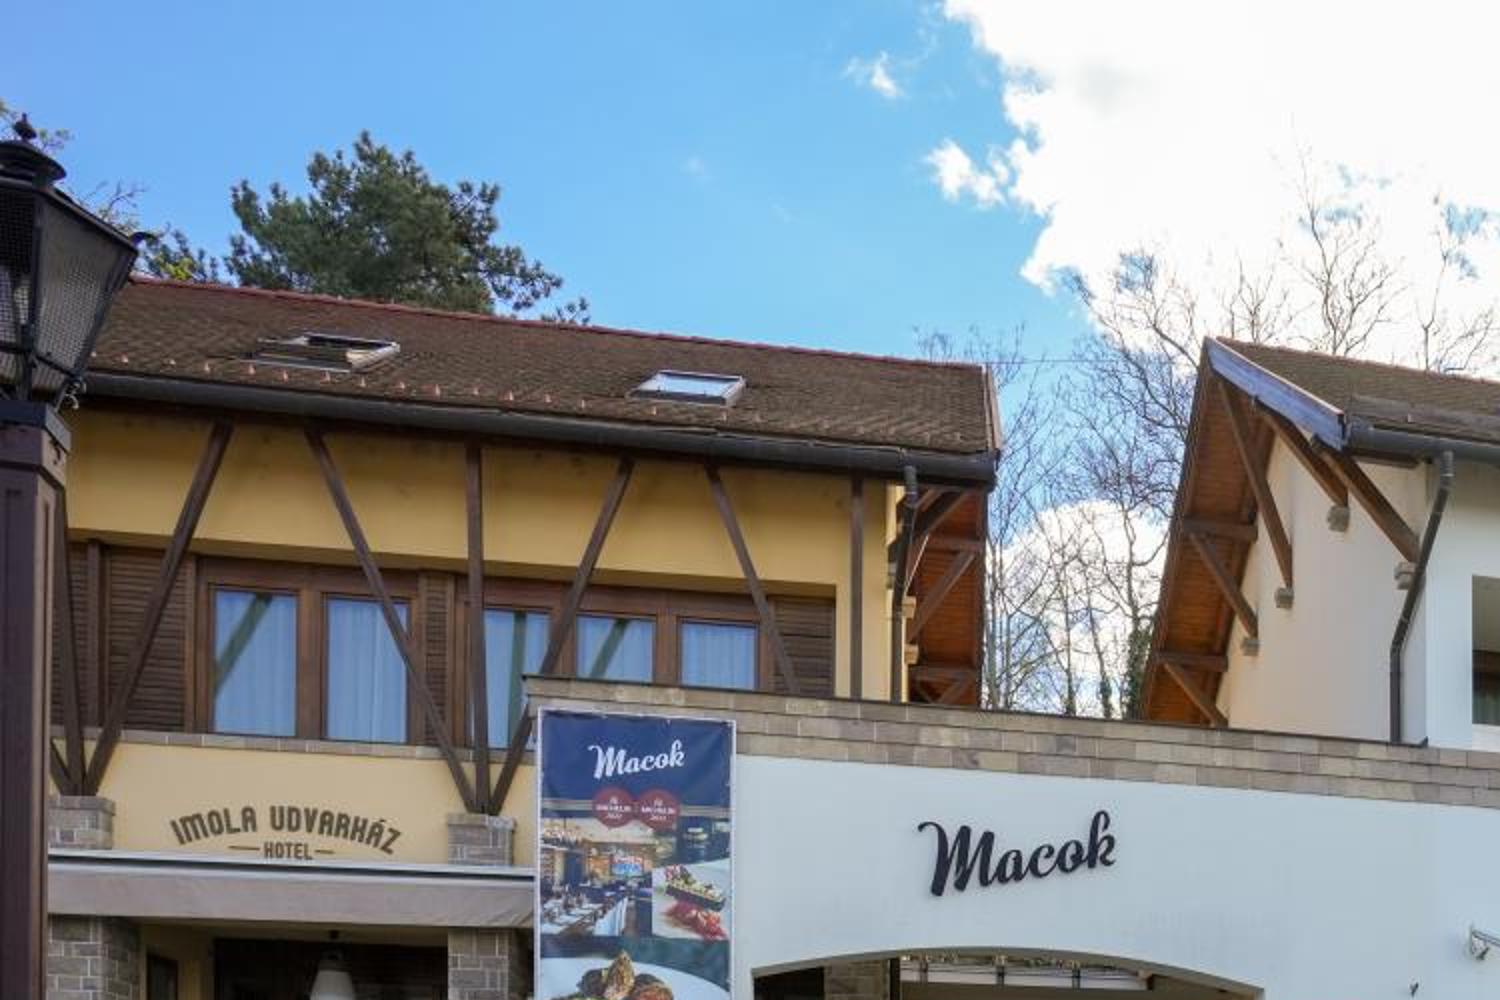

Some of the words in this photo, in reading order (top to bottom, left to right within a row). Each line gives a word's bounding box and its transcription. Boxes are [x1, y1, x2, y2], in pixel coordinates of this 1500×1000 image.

[587, 739, 685, 779] Macok
[170, 805, 257, 845] IMOLA
[269, 805, 402, 855] UDVARHÁZ
[263, 841, 313, 860] HOTEL
[917, 810, 1116, 897] Macok
